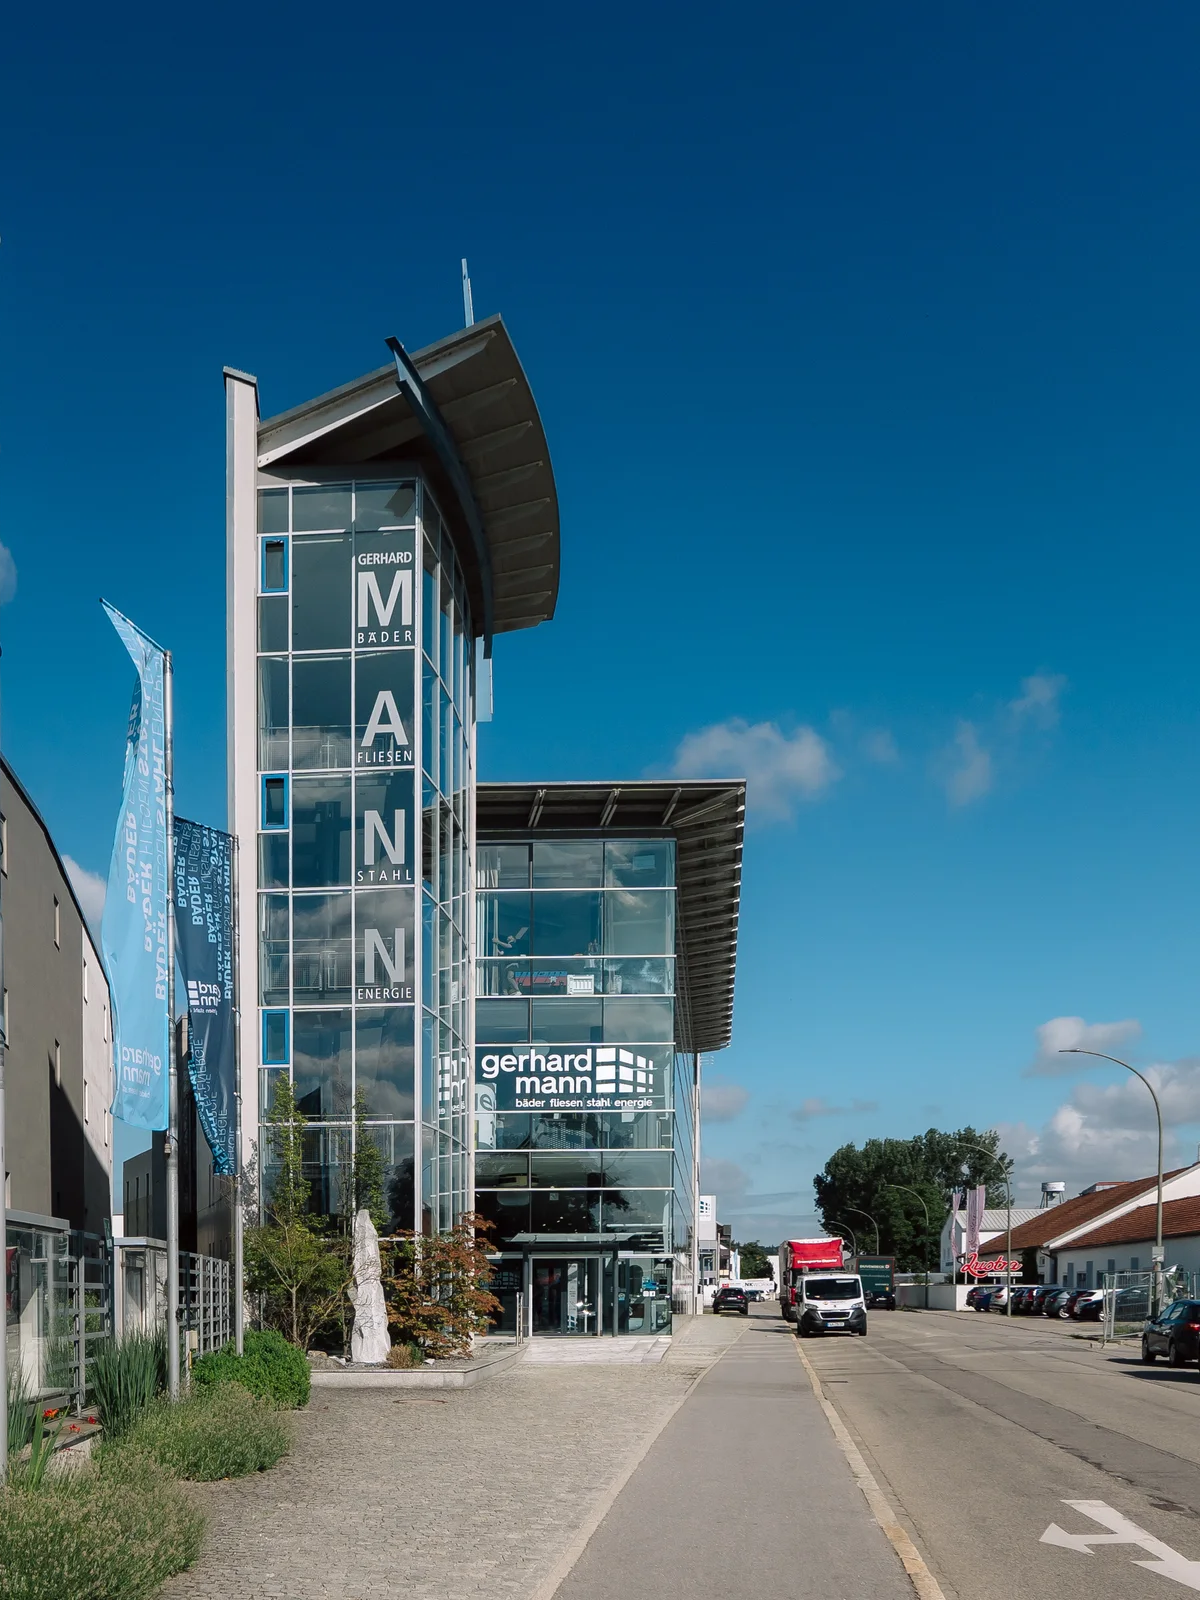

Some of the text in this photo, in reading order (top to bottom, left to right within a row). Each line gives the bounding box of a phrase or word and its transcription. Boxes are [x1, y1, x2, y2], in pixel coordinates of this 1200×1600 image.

[358, 551, 412, 565] GERHARD
[358, 630, 412, 644] BÄDER
[358, 750, 412, 763] FLIESEN
[358, 869, 411, 882] STAHL
[358, 987, 412, 1000] ENERGIE
[481, 1048, 592, 1078] gerhard
[515, 1076, 592, 1094] mann
[515, 1098, 653, 1109] bäder fliesen stahl energie
